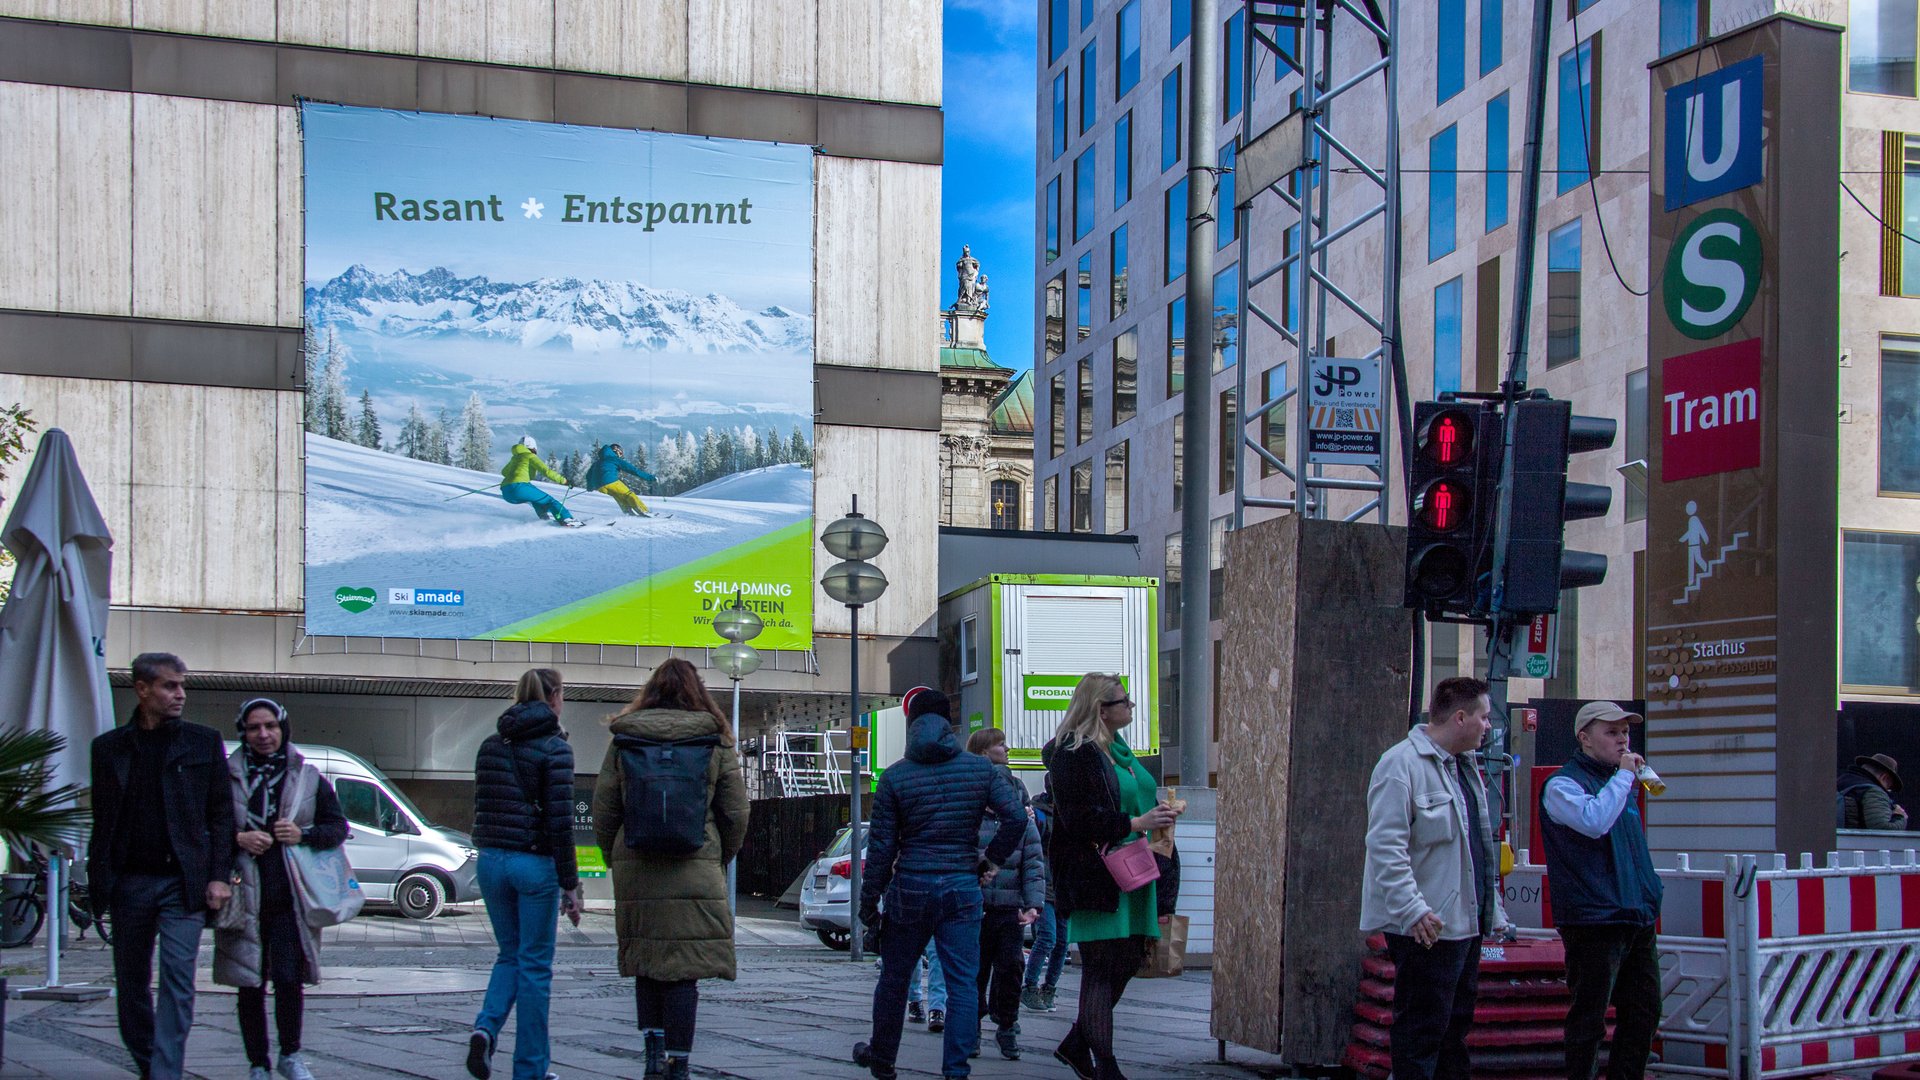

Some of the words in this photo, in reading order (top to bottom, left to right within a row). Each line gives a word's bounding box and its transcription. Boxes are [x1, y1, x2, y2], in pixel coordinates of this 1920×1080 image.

[1685, 79, 1741, 182] U
[374, 192, 505, 222] Rasant
[561, 194, 753, 232] Entspannt
[1681, 222, 1746, 326] S
[1314, 365, 1361, 397] JP
[1340, 388, 1375, 398] Power
[1664, 387, 1756, 436] Tram
[1316, 432, 1373, 441] www.jp-power.de
[1315, 442, 1374, 452] info@jp-power.de
[394, 592, 409, 601] Ski
[693, 580, 792, 597] SCHLADMING
[389, 608, 464, 617] www.skiamade.com
[693, 616, 711, 625] Wir
[778, 618, 794, 628] da.
[1693, 640, 1745, 658] Stachus
